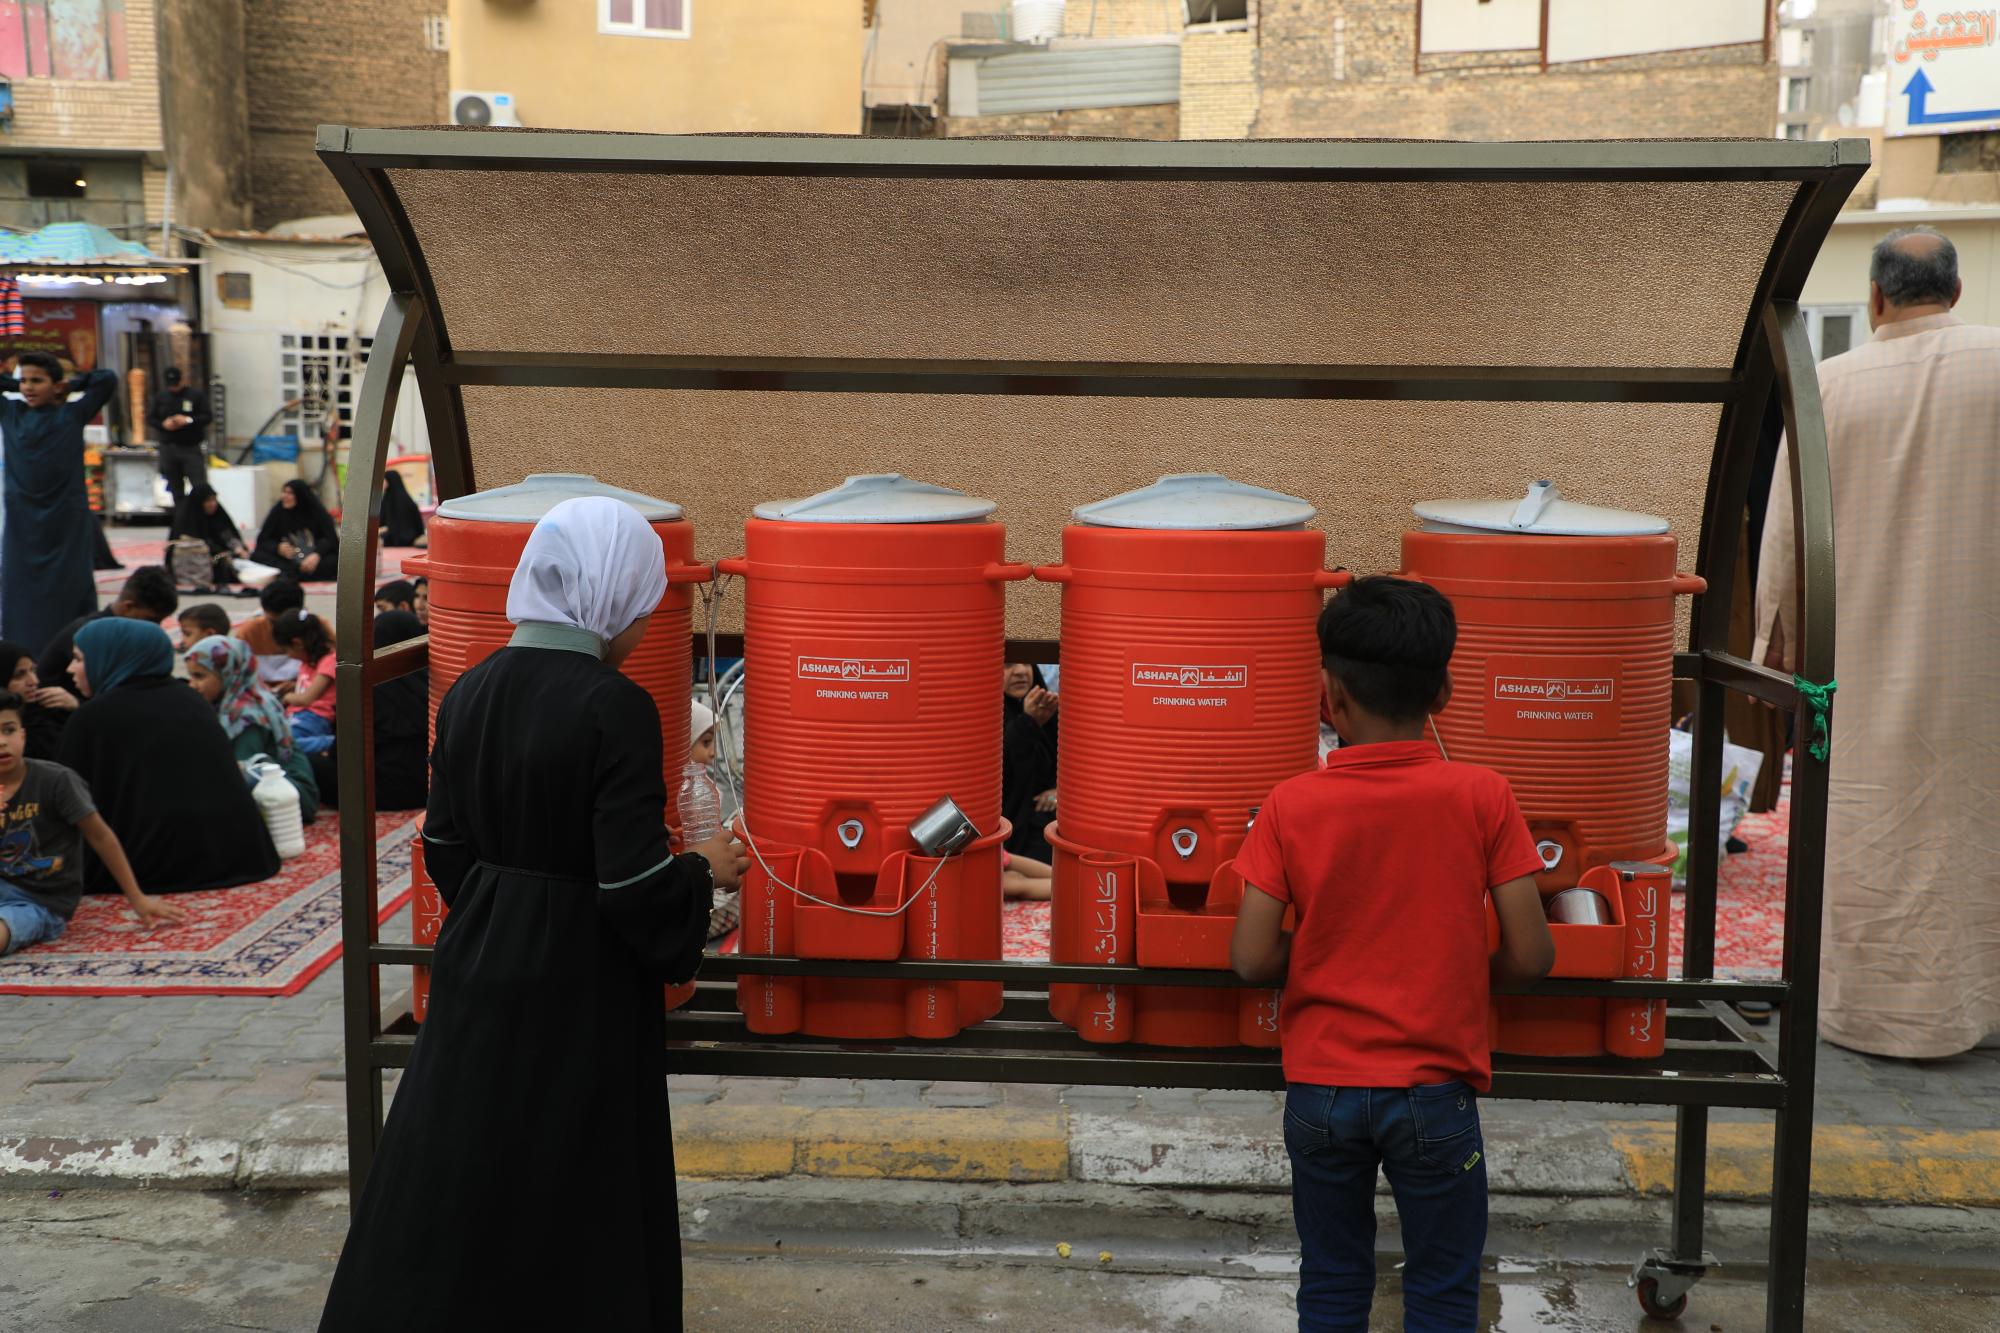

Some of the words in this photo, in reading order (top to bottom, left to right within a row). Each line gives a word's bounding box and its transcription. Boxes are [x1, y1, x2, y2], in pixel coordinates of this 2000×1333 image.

[1895, 9, 1996, 63] التفتيش
[801, 663, 841, 674] ASHAFA
[861, 664, 905, 676] الشفا
[1136, 670, 1179, 681] ASHAFA
[1200, 671, 1243, 682] الشفا
[816, 689, 857, 699] DRINKING
[859, 690, 889, 700] WATER
[1499, 683, 1545, 695] ASHAFA
[1566, 683, 1609, 696] الشفا
[1152, 696, 1195, 706] DRINKING
[1197, 697, 1227, 707] WATER
[1516, 710, 1562, 720] DRINKING
[1564, 711, 1593, 720] WATER
[764, 991, 773, 1017] USED
[927, 994, 936, 1019] NEW
